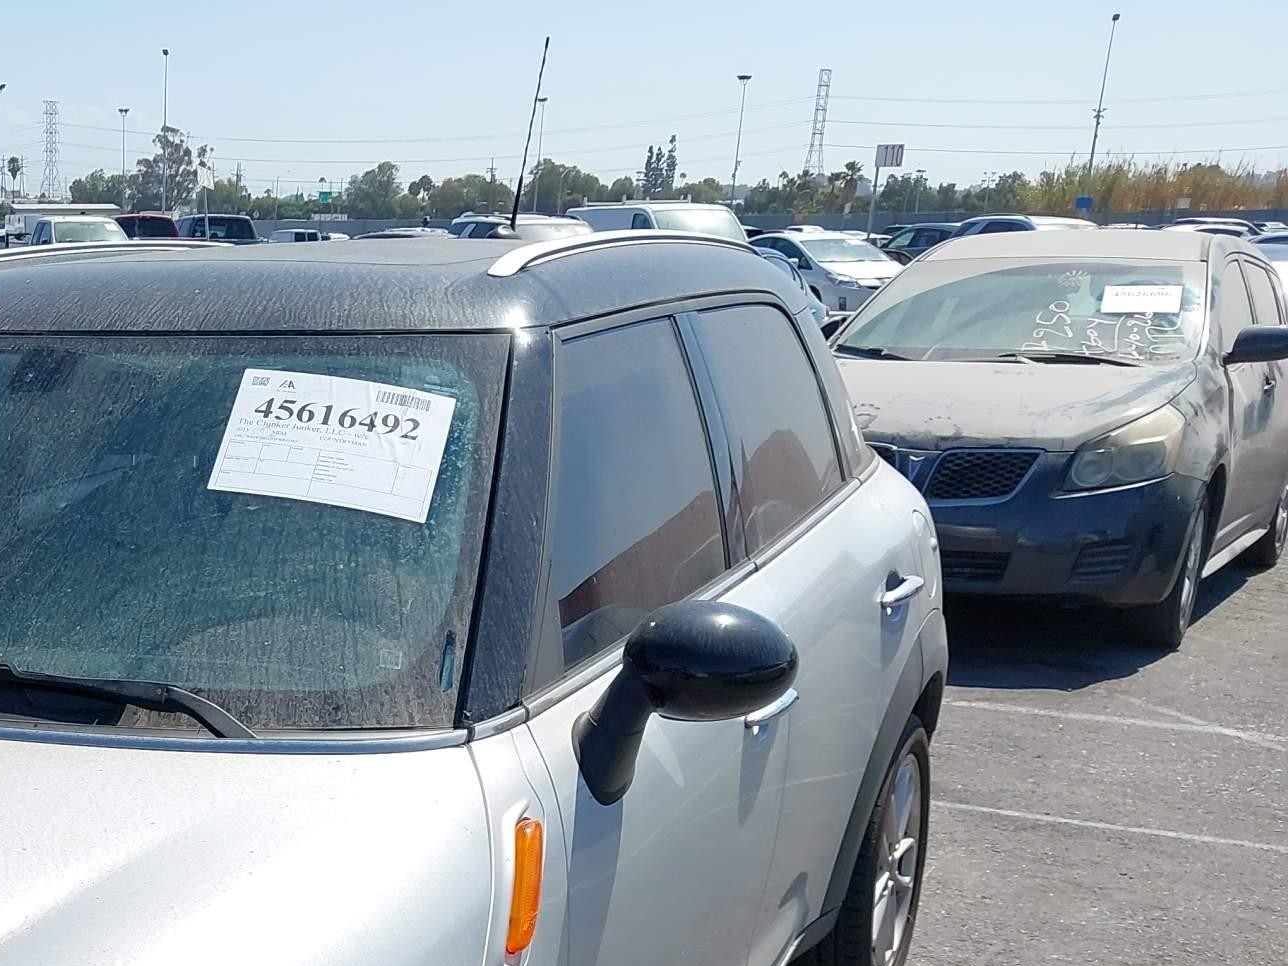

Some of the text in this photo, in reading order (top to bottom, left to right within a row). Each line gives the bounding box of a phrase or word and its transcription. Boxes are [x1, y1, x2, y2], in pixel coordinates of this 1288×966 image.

[239, 417, 253, 426] The
[256, 419, 291, 429] Clunker
[254, 397, 421, 441] 45616492
